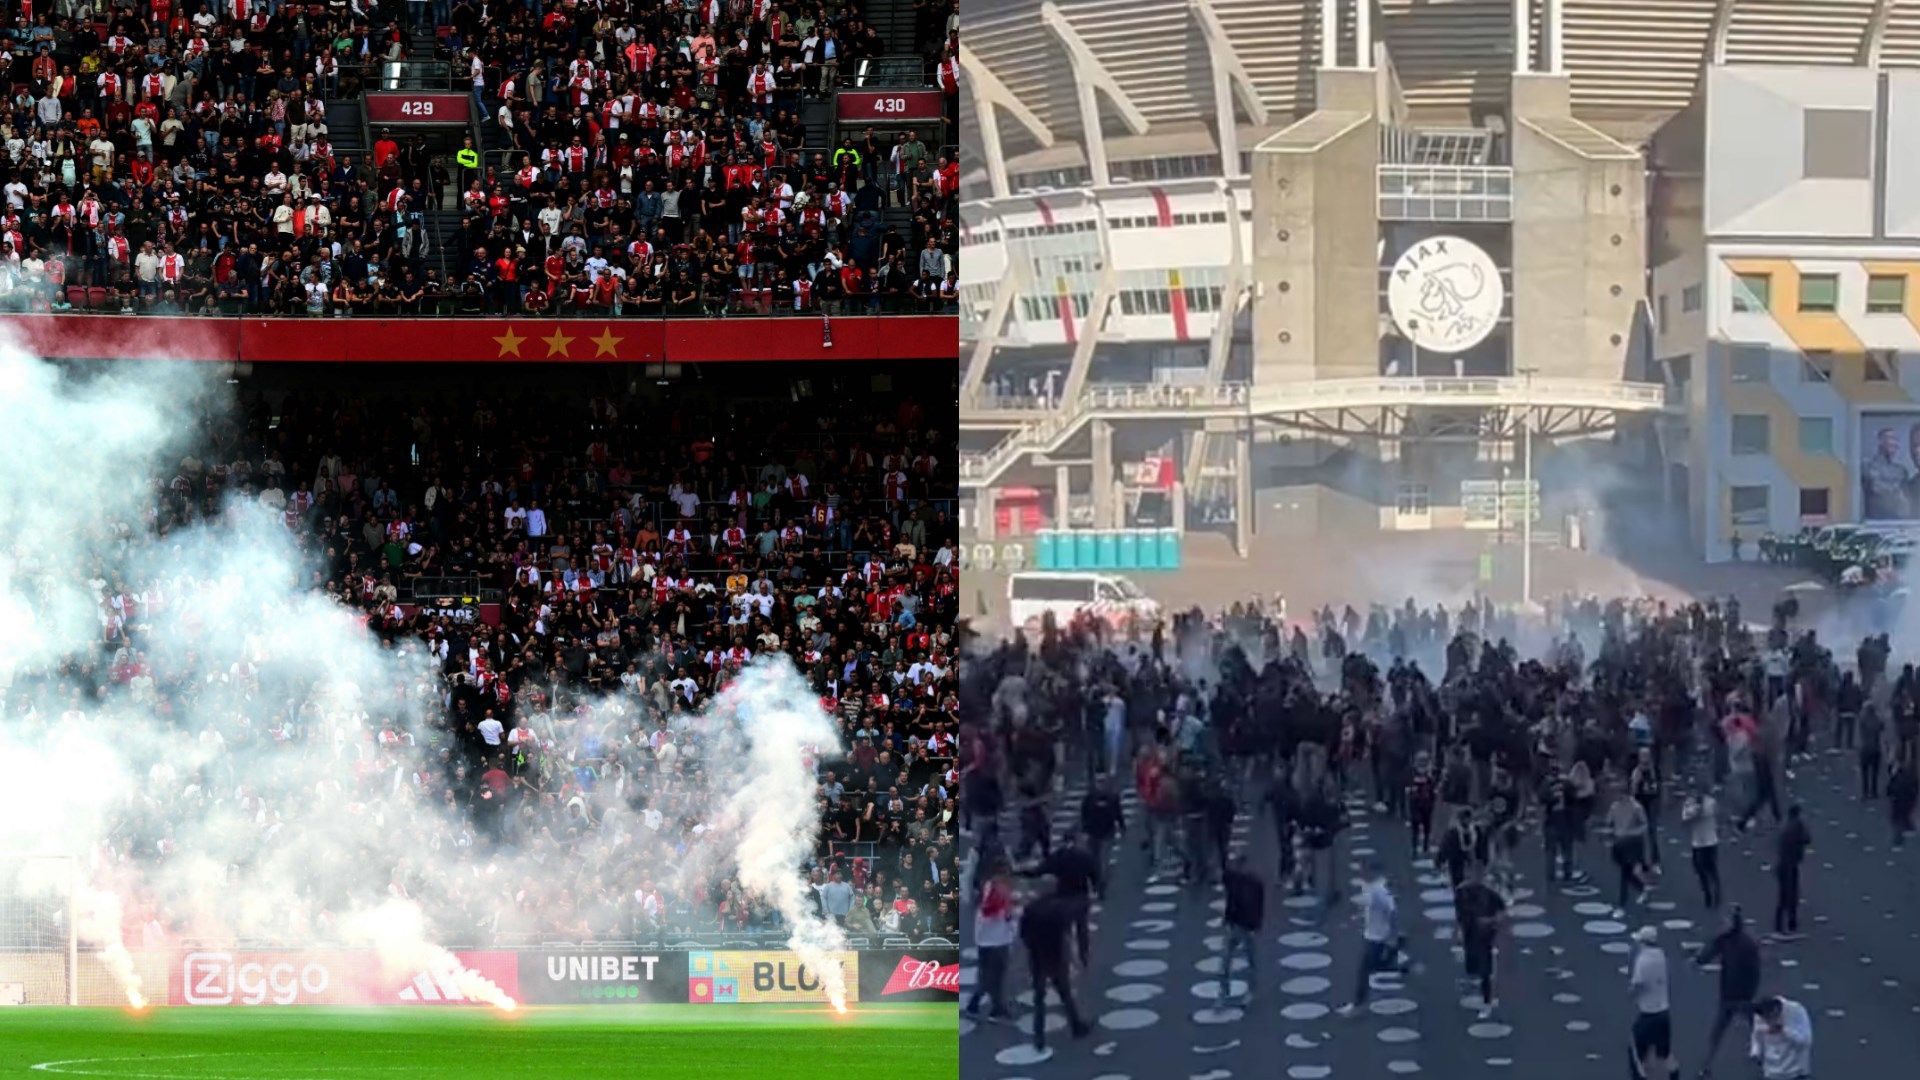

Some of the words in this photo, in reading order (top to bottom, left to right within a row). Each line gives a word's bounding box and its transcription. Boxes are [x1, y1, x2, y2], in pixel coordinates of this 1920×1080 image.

[401, 101, 434, 115] 429
[874, 98, 906, 113] 430
[1396, 239, 1449, 283] AJAX
[817, 508, 825, 522] 6
[547, 956, 660, 981] UNIBET
[753, 961, 845, 992] BLO
